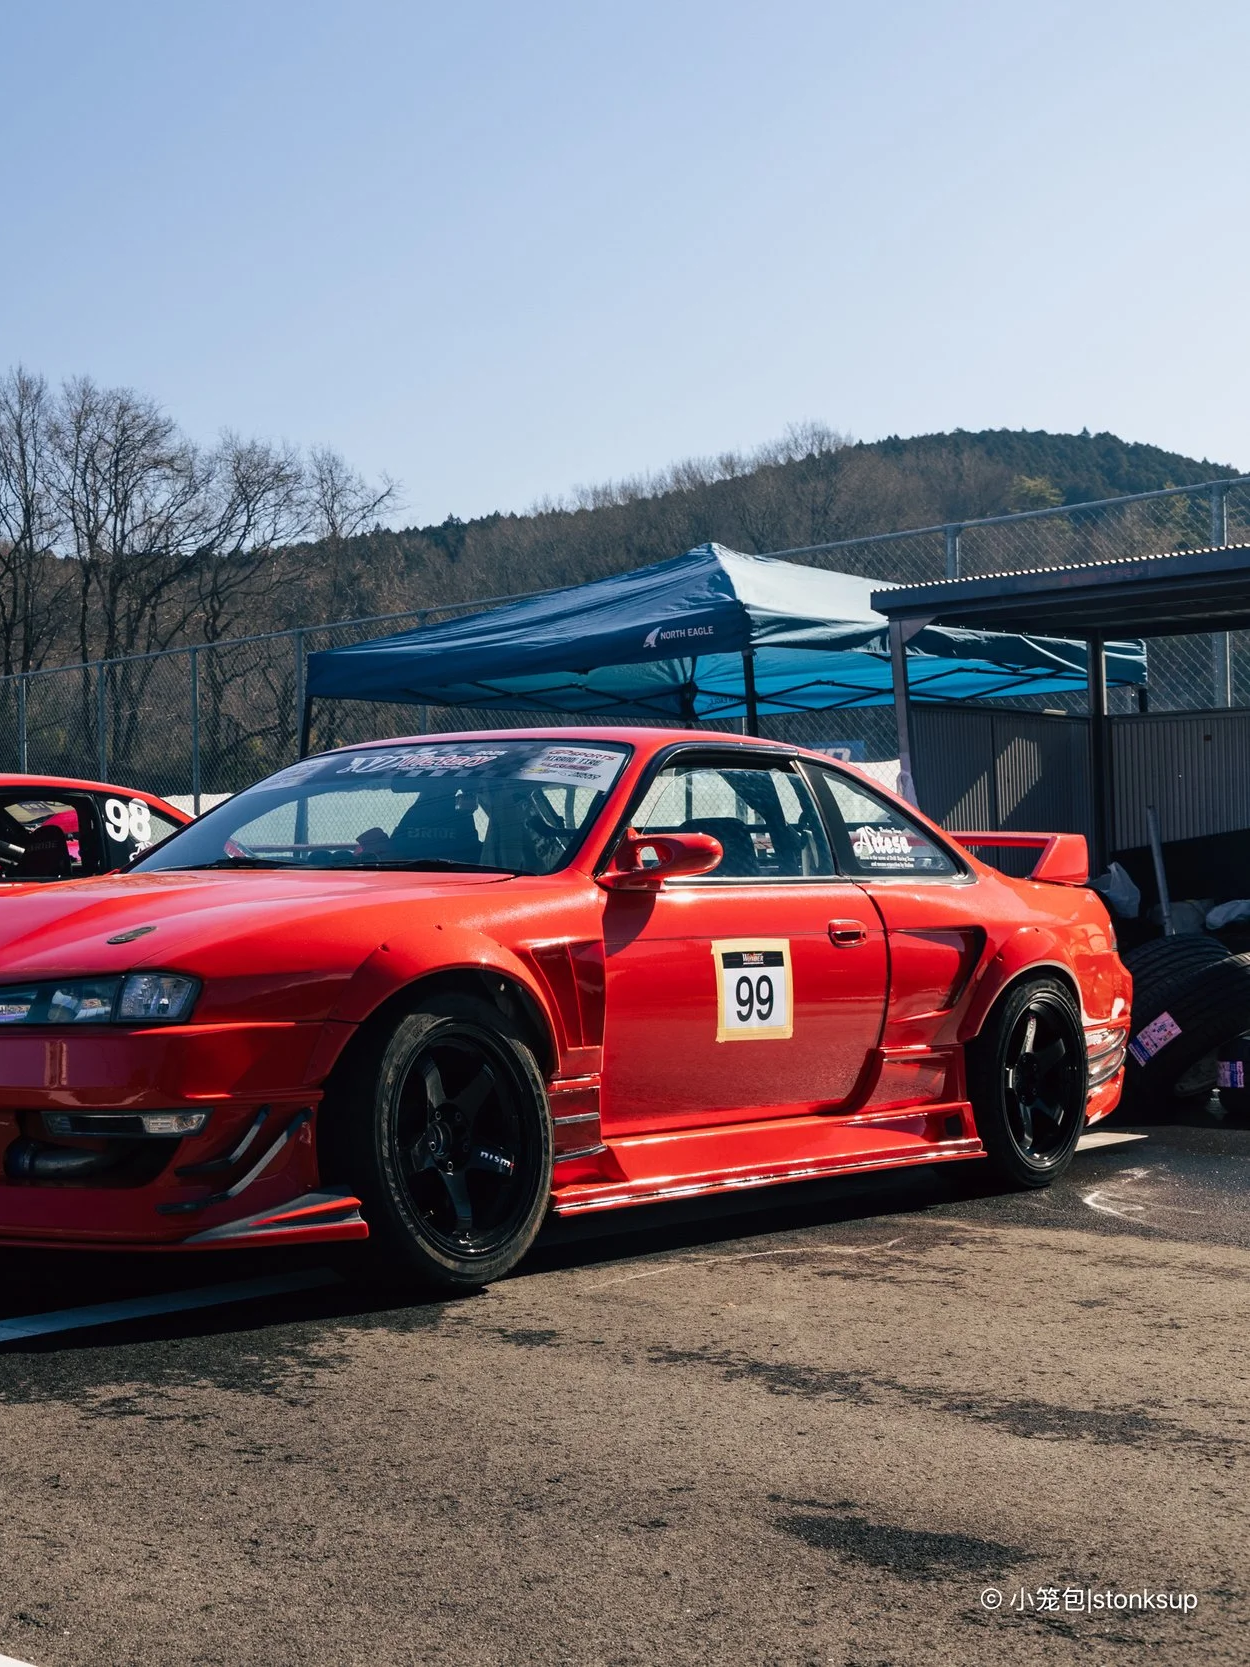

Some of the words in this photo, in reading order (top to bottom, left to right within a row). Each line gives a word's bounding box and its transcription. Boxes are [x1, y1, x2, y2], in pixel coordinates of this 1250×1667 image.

[660, 629, 686, 640] NORTH
[687, 626, 714, 637] EAGLE
[398, 751, 498, 769] Victory
[105, 798, 152, 842] 98
[735, 974, 774, 1022] 99
